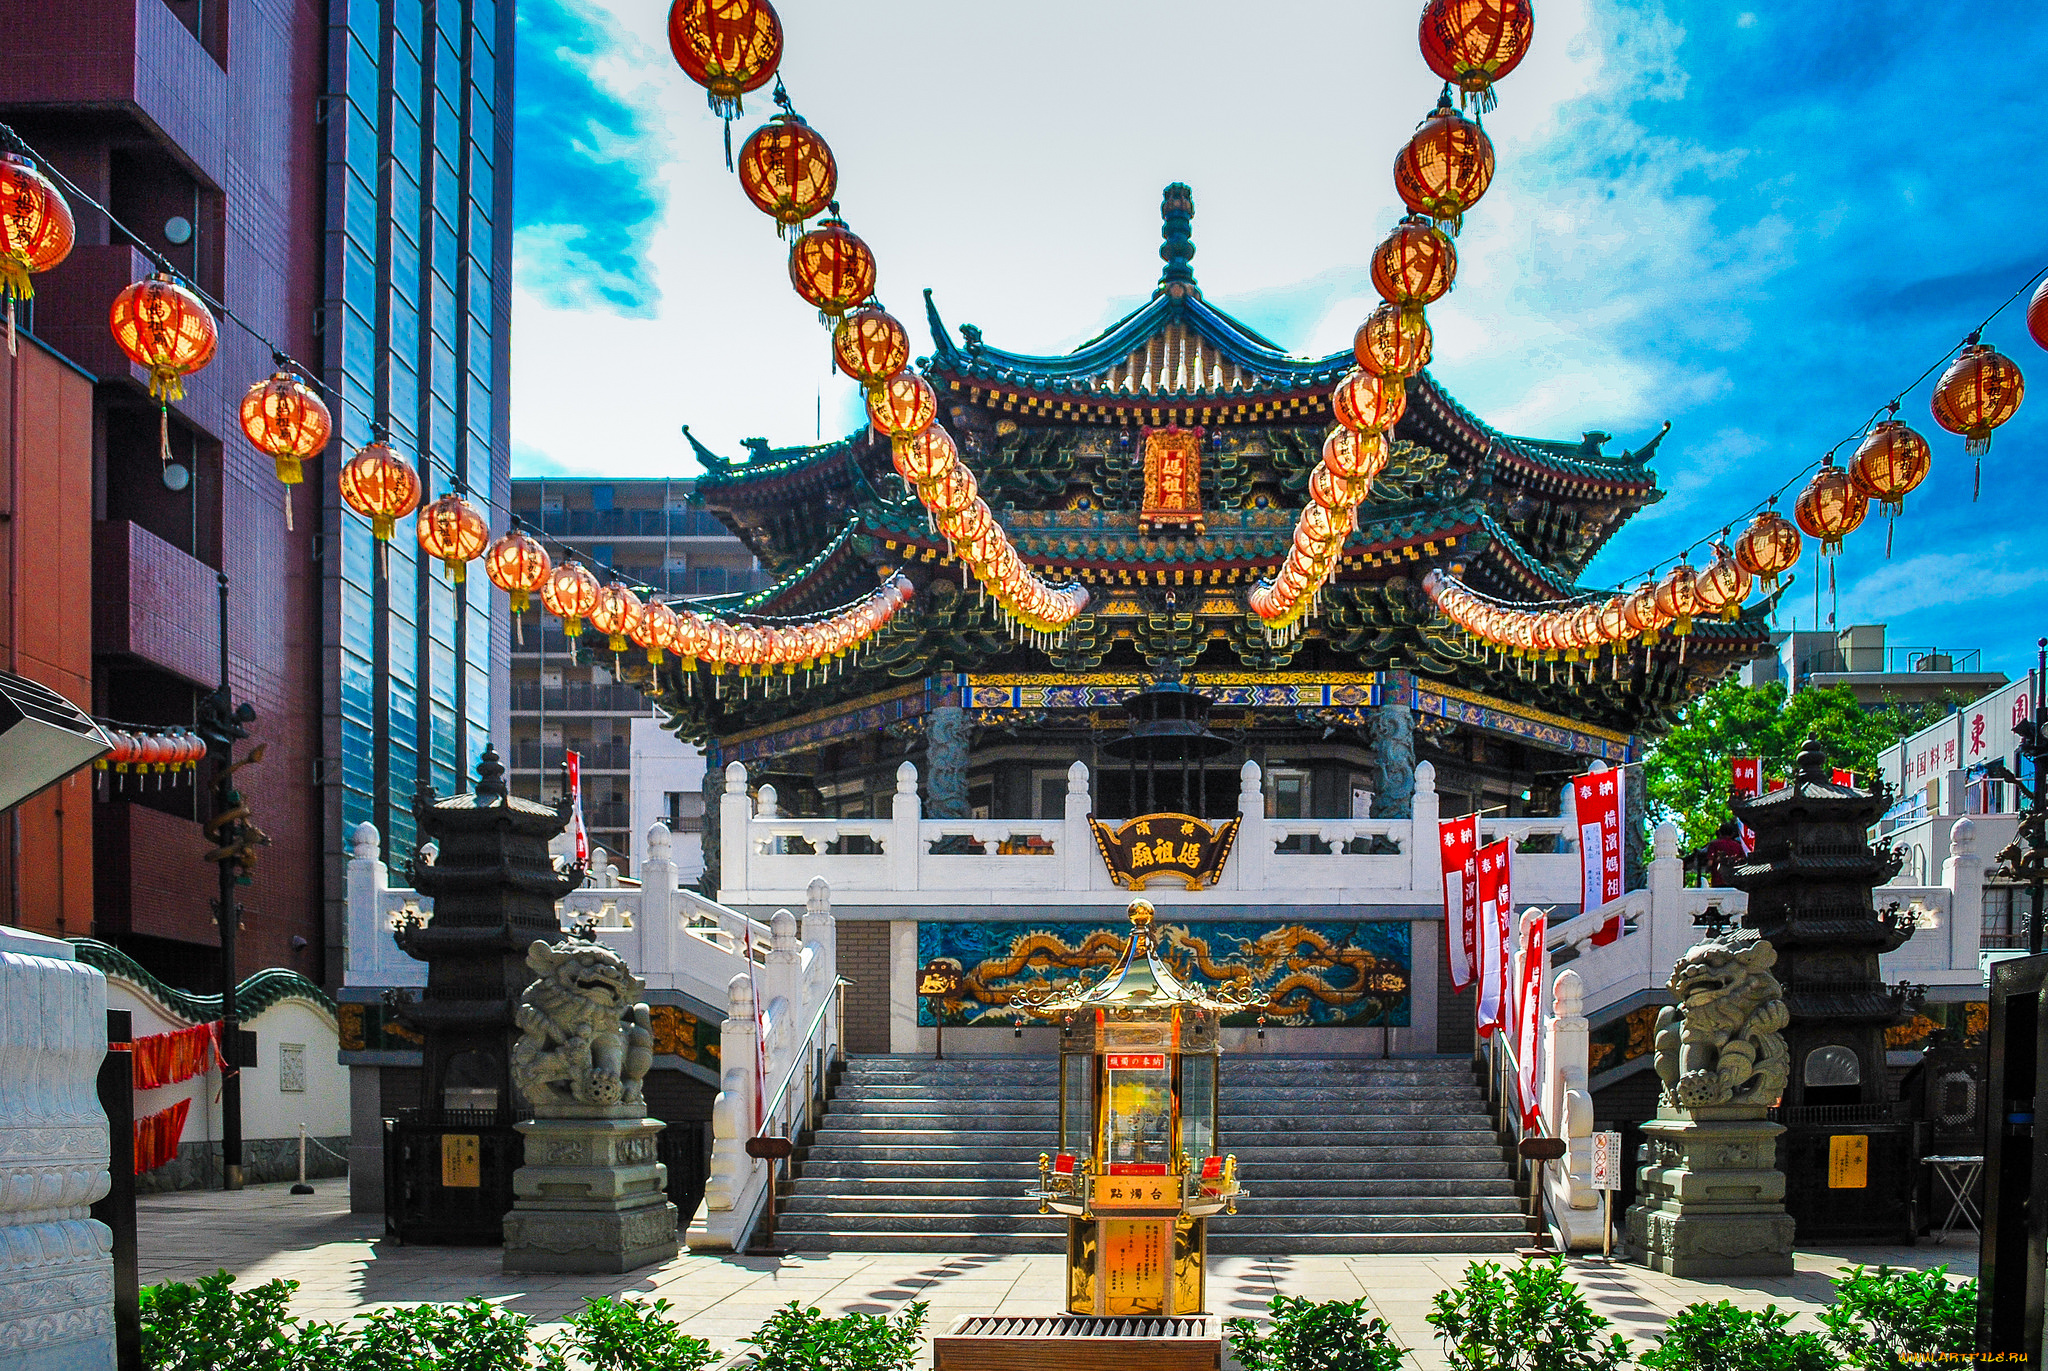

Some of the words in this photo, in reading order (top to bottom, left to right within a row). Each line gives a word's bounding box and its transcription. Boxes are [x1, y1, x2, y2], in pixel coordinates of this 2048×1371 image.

[1162, 458, 1183, 509] 媽祖廟
[1905, 739, 1955, 782] 中国料理
[1580, 780, 1614, 800] 奉納
[1443, 827, 1473, 848] 奉納
[1131, 837, 1202, 870] 媽祖廟
[1481, 852, 1506, 874] 奉納
